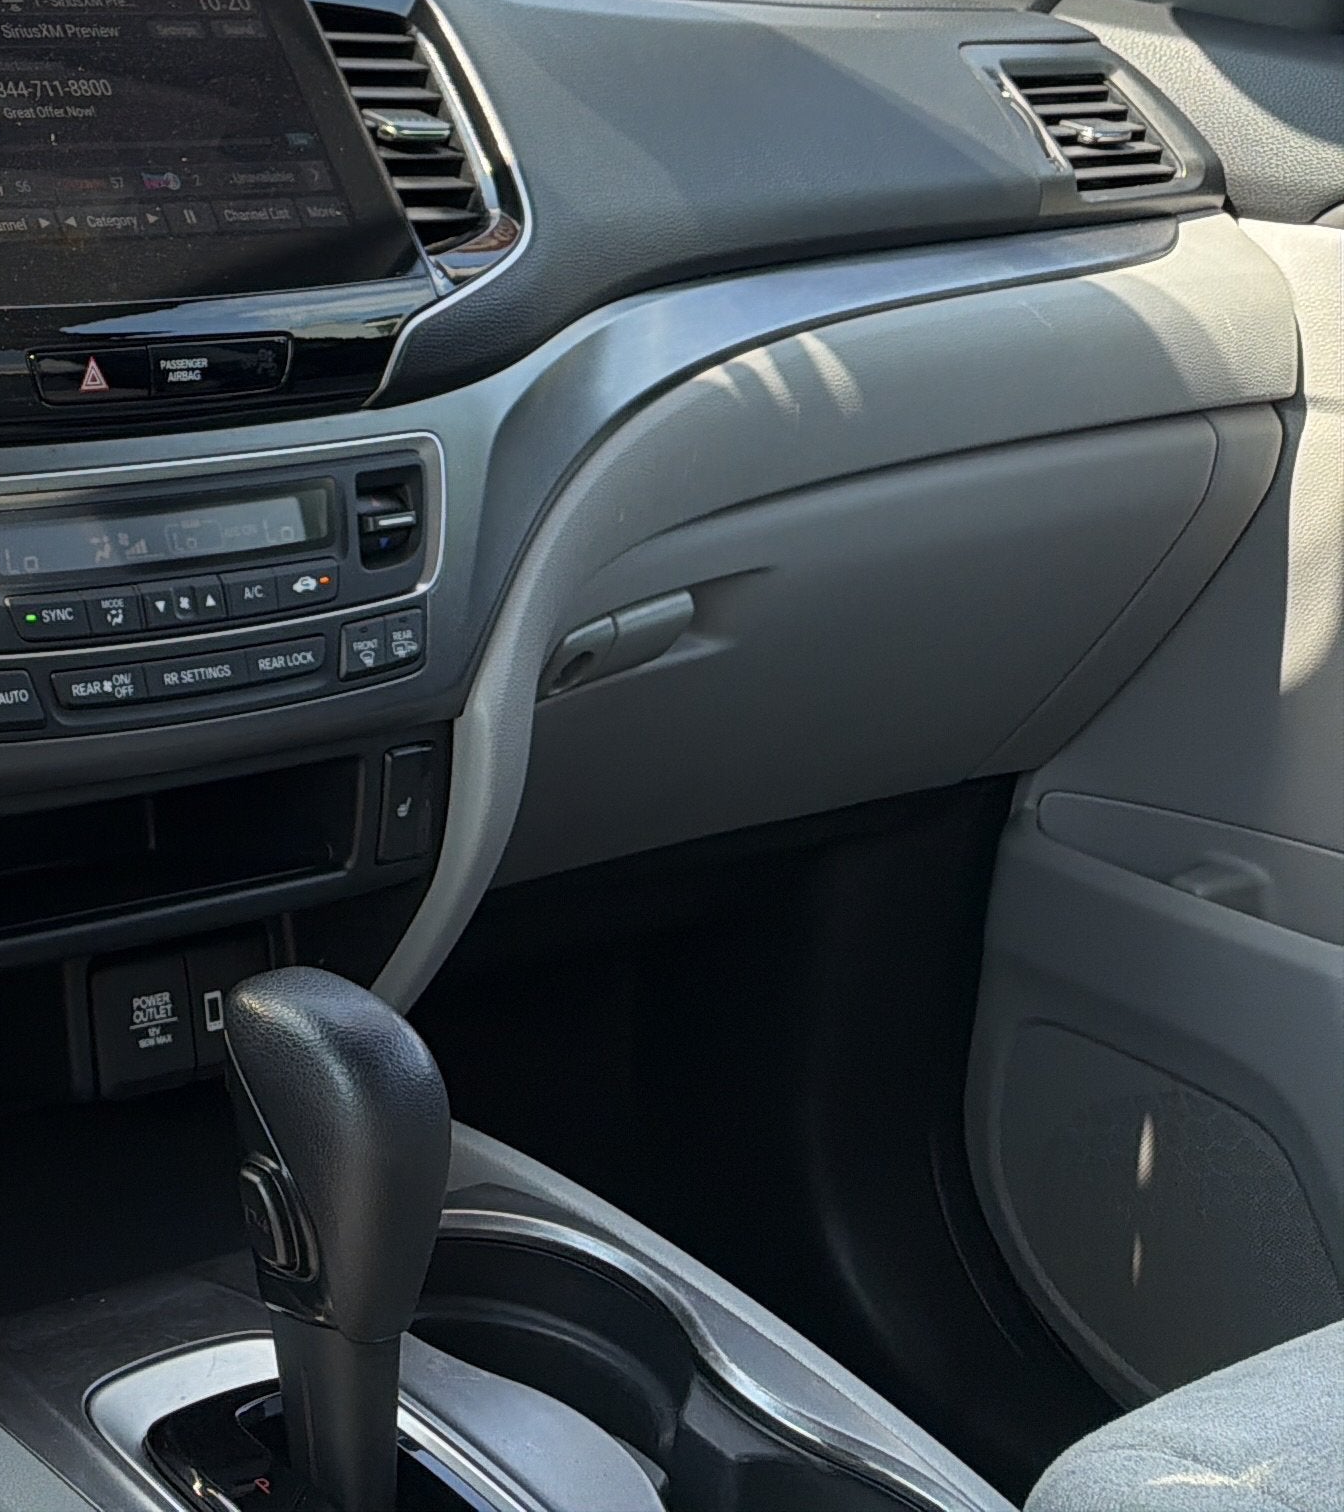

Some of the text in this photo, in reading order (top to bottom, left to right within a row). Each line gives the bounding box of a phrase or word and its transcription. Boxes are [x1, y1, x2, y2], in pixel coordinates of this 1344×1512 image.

[0, 23, 120, 39] SiriusXM Preview
[3, 107, 36, 119] Great
[224, 207, 269, 222] Channel
[87, 215, 138, 231] Category
[159, 357, 209, 371] PASSENGER
[167, 369, 202, 383] AIRBAG
[244, 585, 263, 599] A/C
[101, 598, 124, 609] MODE
[41, 608, 74, 623] SYNC
[392, 629, 413, 640] REAR
[352, 638, 379, 652] FRONT
[258, 650, 315, 671] REAR LOCK
[163, 664, 232, 686] RR SETTINGS
[71, 673, 132, 697] REAR ON/
[114, 686, 135, 699] OFF
[132, 991, 171, 1011] POWER
[132, 1004, 174, 1024] OUTLET
[254, 1477, 272, 1495] P
